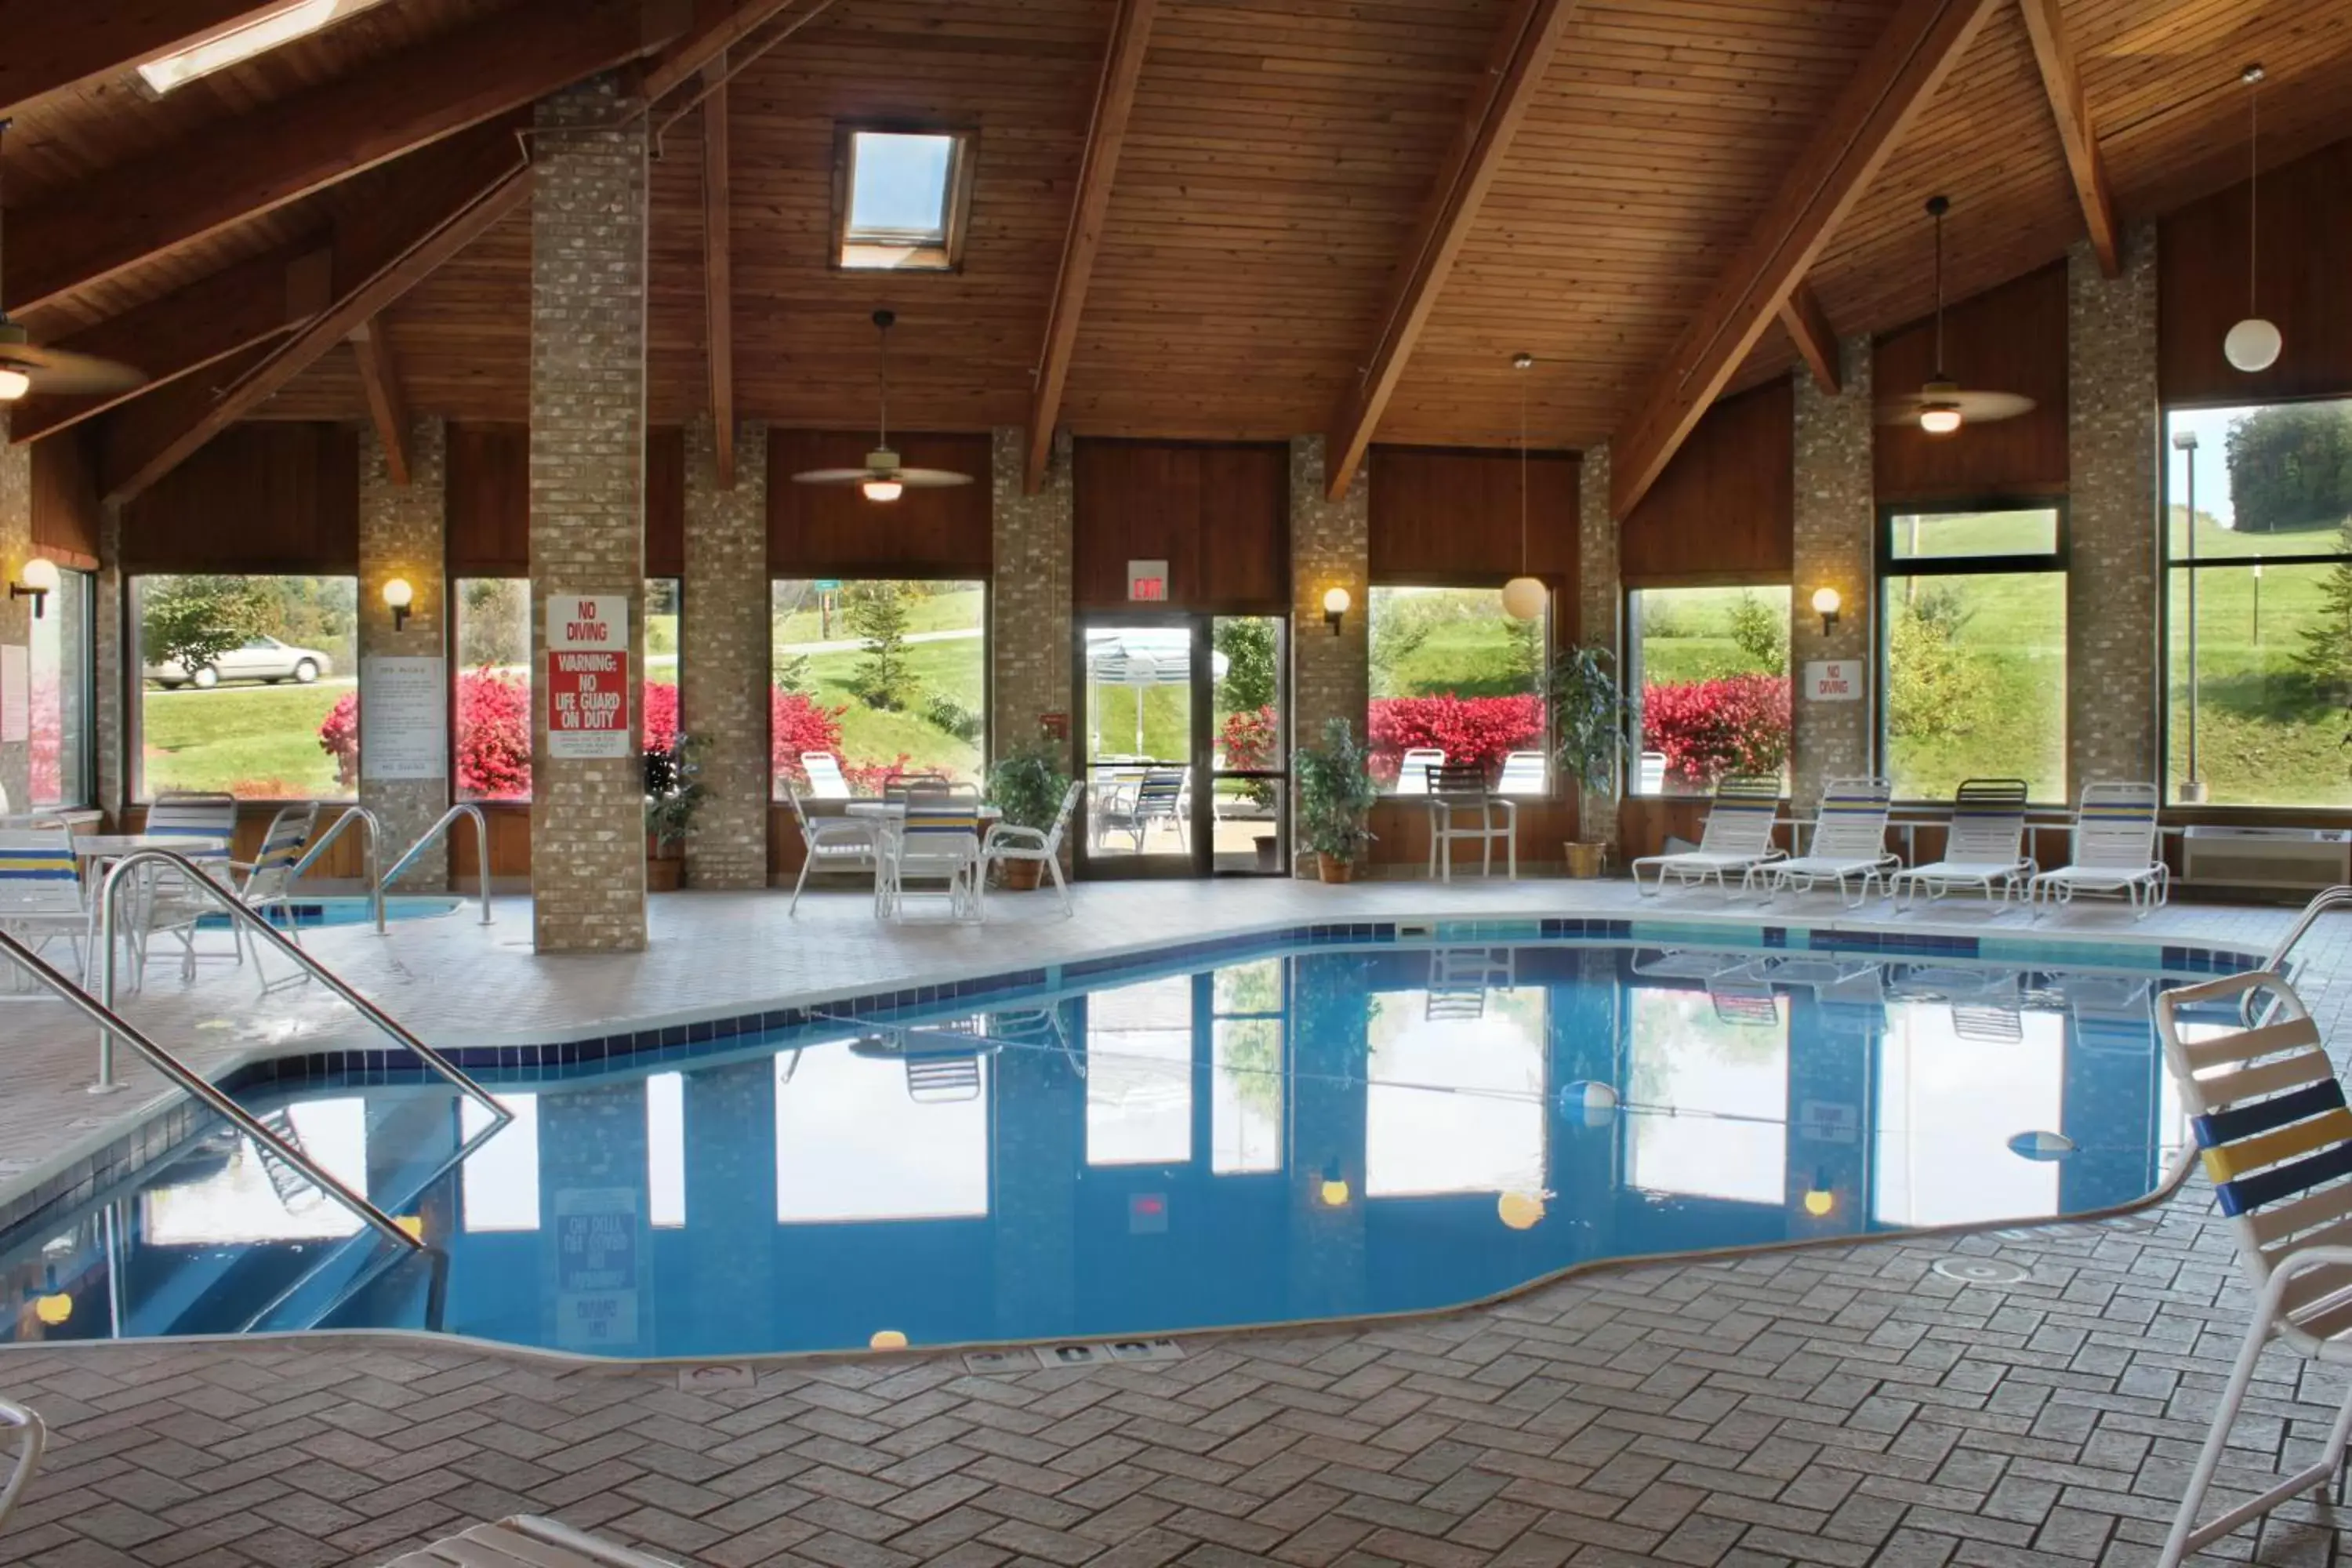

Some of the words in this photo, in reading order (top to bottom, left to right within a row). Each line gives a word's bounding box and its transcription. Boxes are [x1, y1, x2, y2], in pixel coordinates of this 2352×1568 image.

[1134, 578, 1162, 599] EXIT
[579, 601, 596, 619] NO
[567, 622, 607, 641] DIVING
[557, 654, 617, 672] WARNING:
[1827, 665, 1840, 678] NO
[579, 674, 597, 691] NO
[1820, 680, 1848, 694] DIVING
[555, 692, 575, 711] LIFE
[580, 692, 620, 710] GUARD
[562, 711, 579, 728] ON
[584, 710, 615, 728] DUTY
